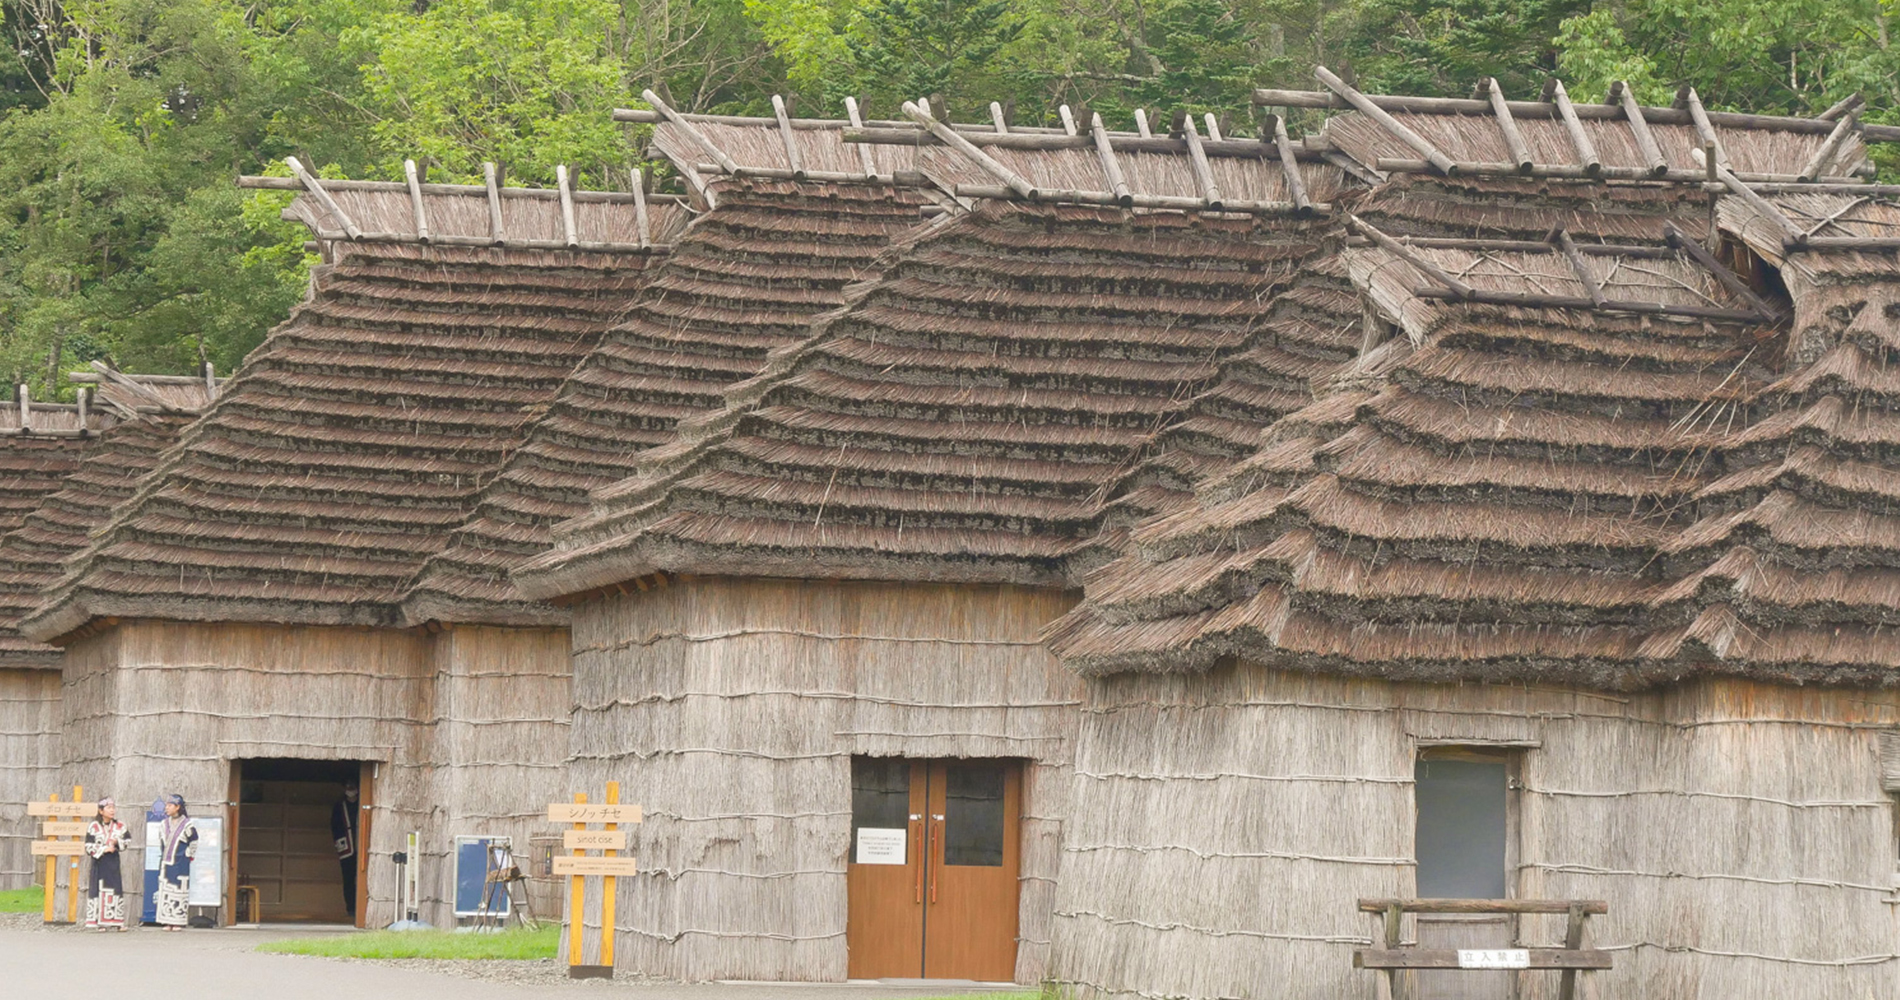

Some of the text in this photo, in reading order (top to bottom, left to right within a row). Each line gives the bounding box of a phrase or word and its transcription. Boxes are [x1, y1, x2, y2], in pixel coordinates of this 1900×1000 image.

[569, 808, 621, 819] シノッ チセ
[577, 835, 597, 844] sinot
[1464, 951, 1525, 962] 立入禁止
